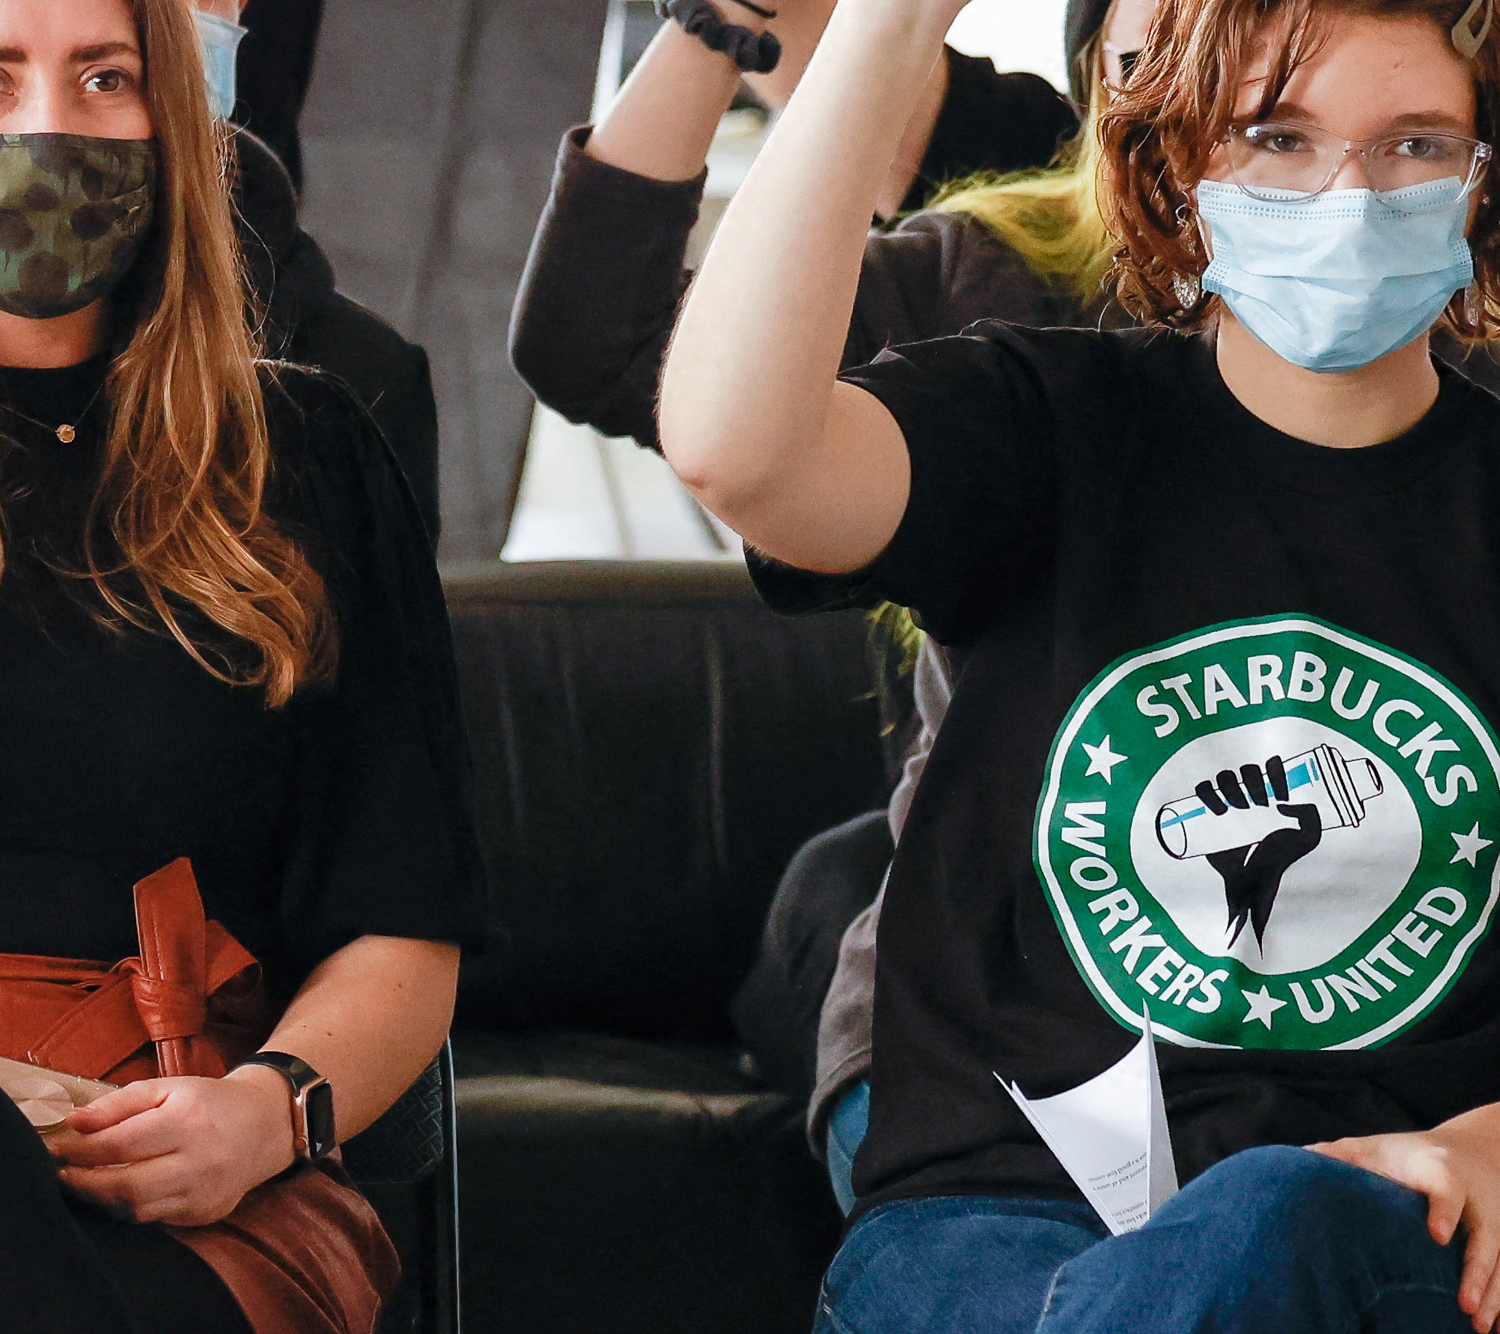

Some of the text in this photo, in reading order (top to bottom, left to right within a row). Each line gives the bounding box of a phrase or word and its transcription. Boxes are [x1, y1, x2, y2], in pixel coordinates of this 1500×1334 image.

[1136, 650, 1478, 808] STARBUCKS
[1061, 801, 1469, 1025] WORKERS UNITED
